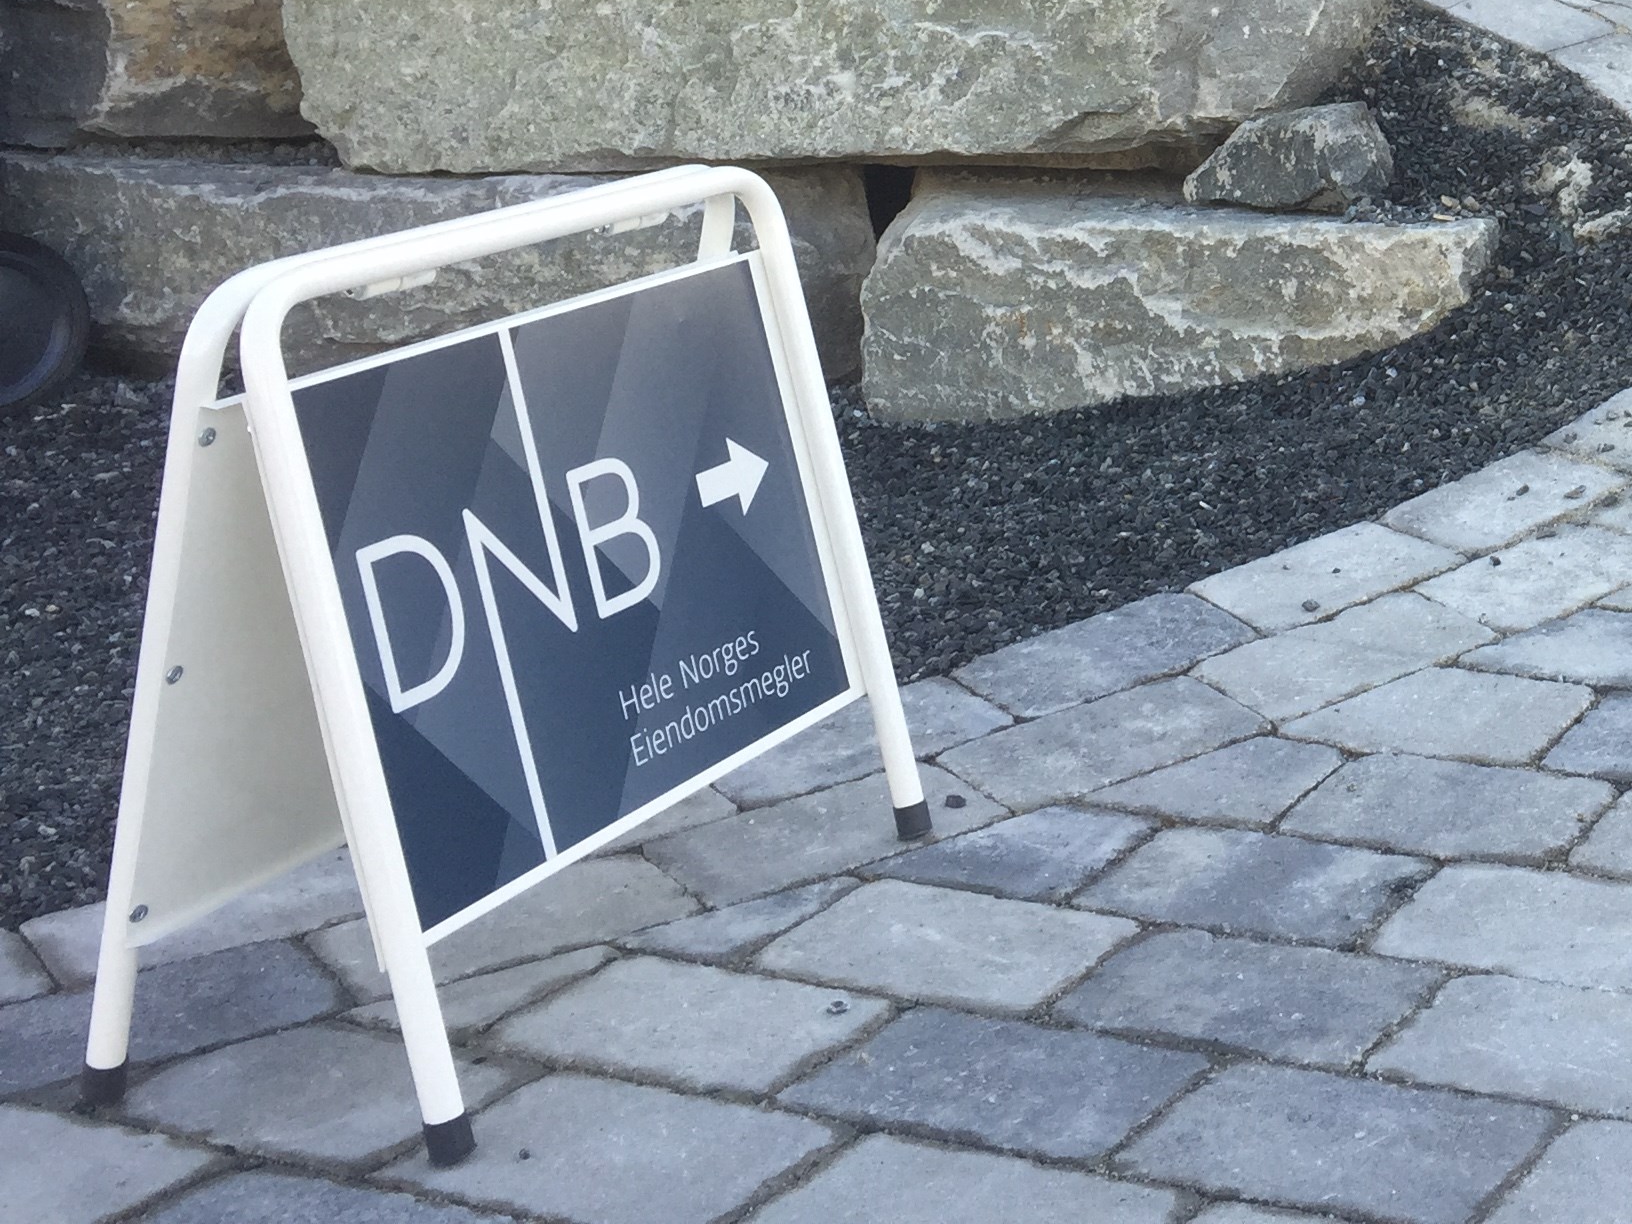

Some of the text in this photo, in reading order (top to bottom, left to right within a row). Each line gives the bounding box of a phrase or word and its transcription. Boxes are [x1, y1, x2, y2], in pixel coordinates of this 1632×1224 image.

[355, 456, 661, 714] DNB
[618, 630, 760, 720] Hele Norges
[630, 649, 811, 767] Eiendomsmegler
